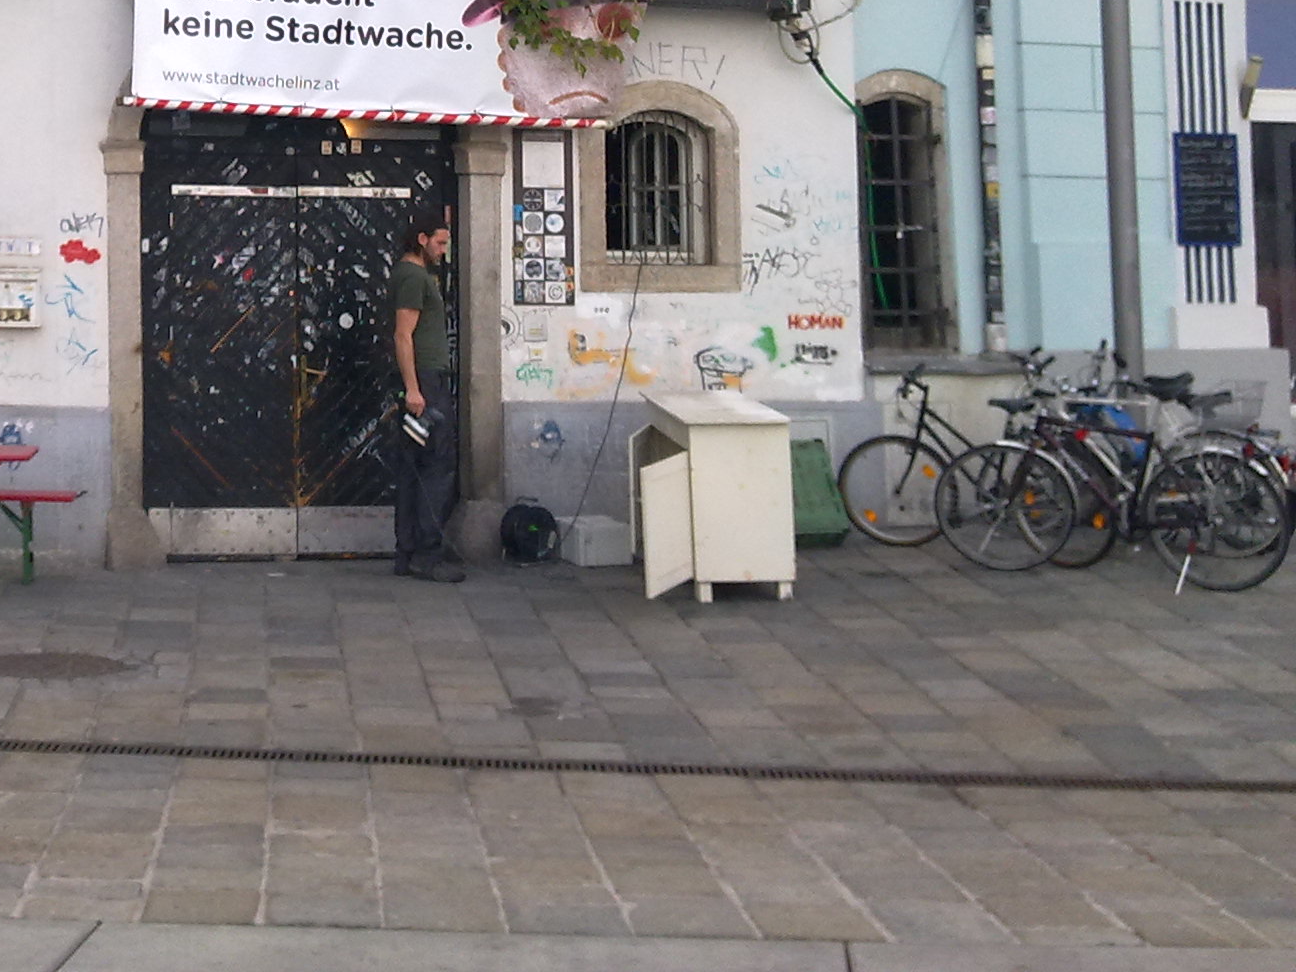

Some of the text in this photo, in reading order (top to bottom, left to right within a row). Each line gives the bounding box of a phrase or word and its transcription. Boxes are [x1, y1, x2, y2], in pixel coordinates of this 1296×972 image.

[162, 7, 473, 52] keine Stadtwache.
[162, 69, 341, 92] www.stadtwachelinz.at
